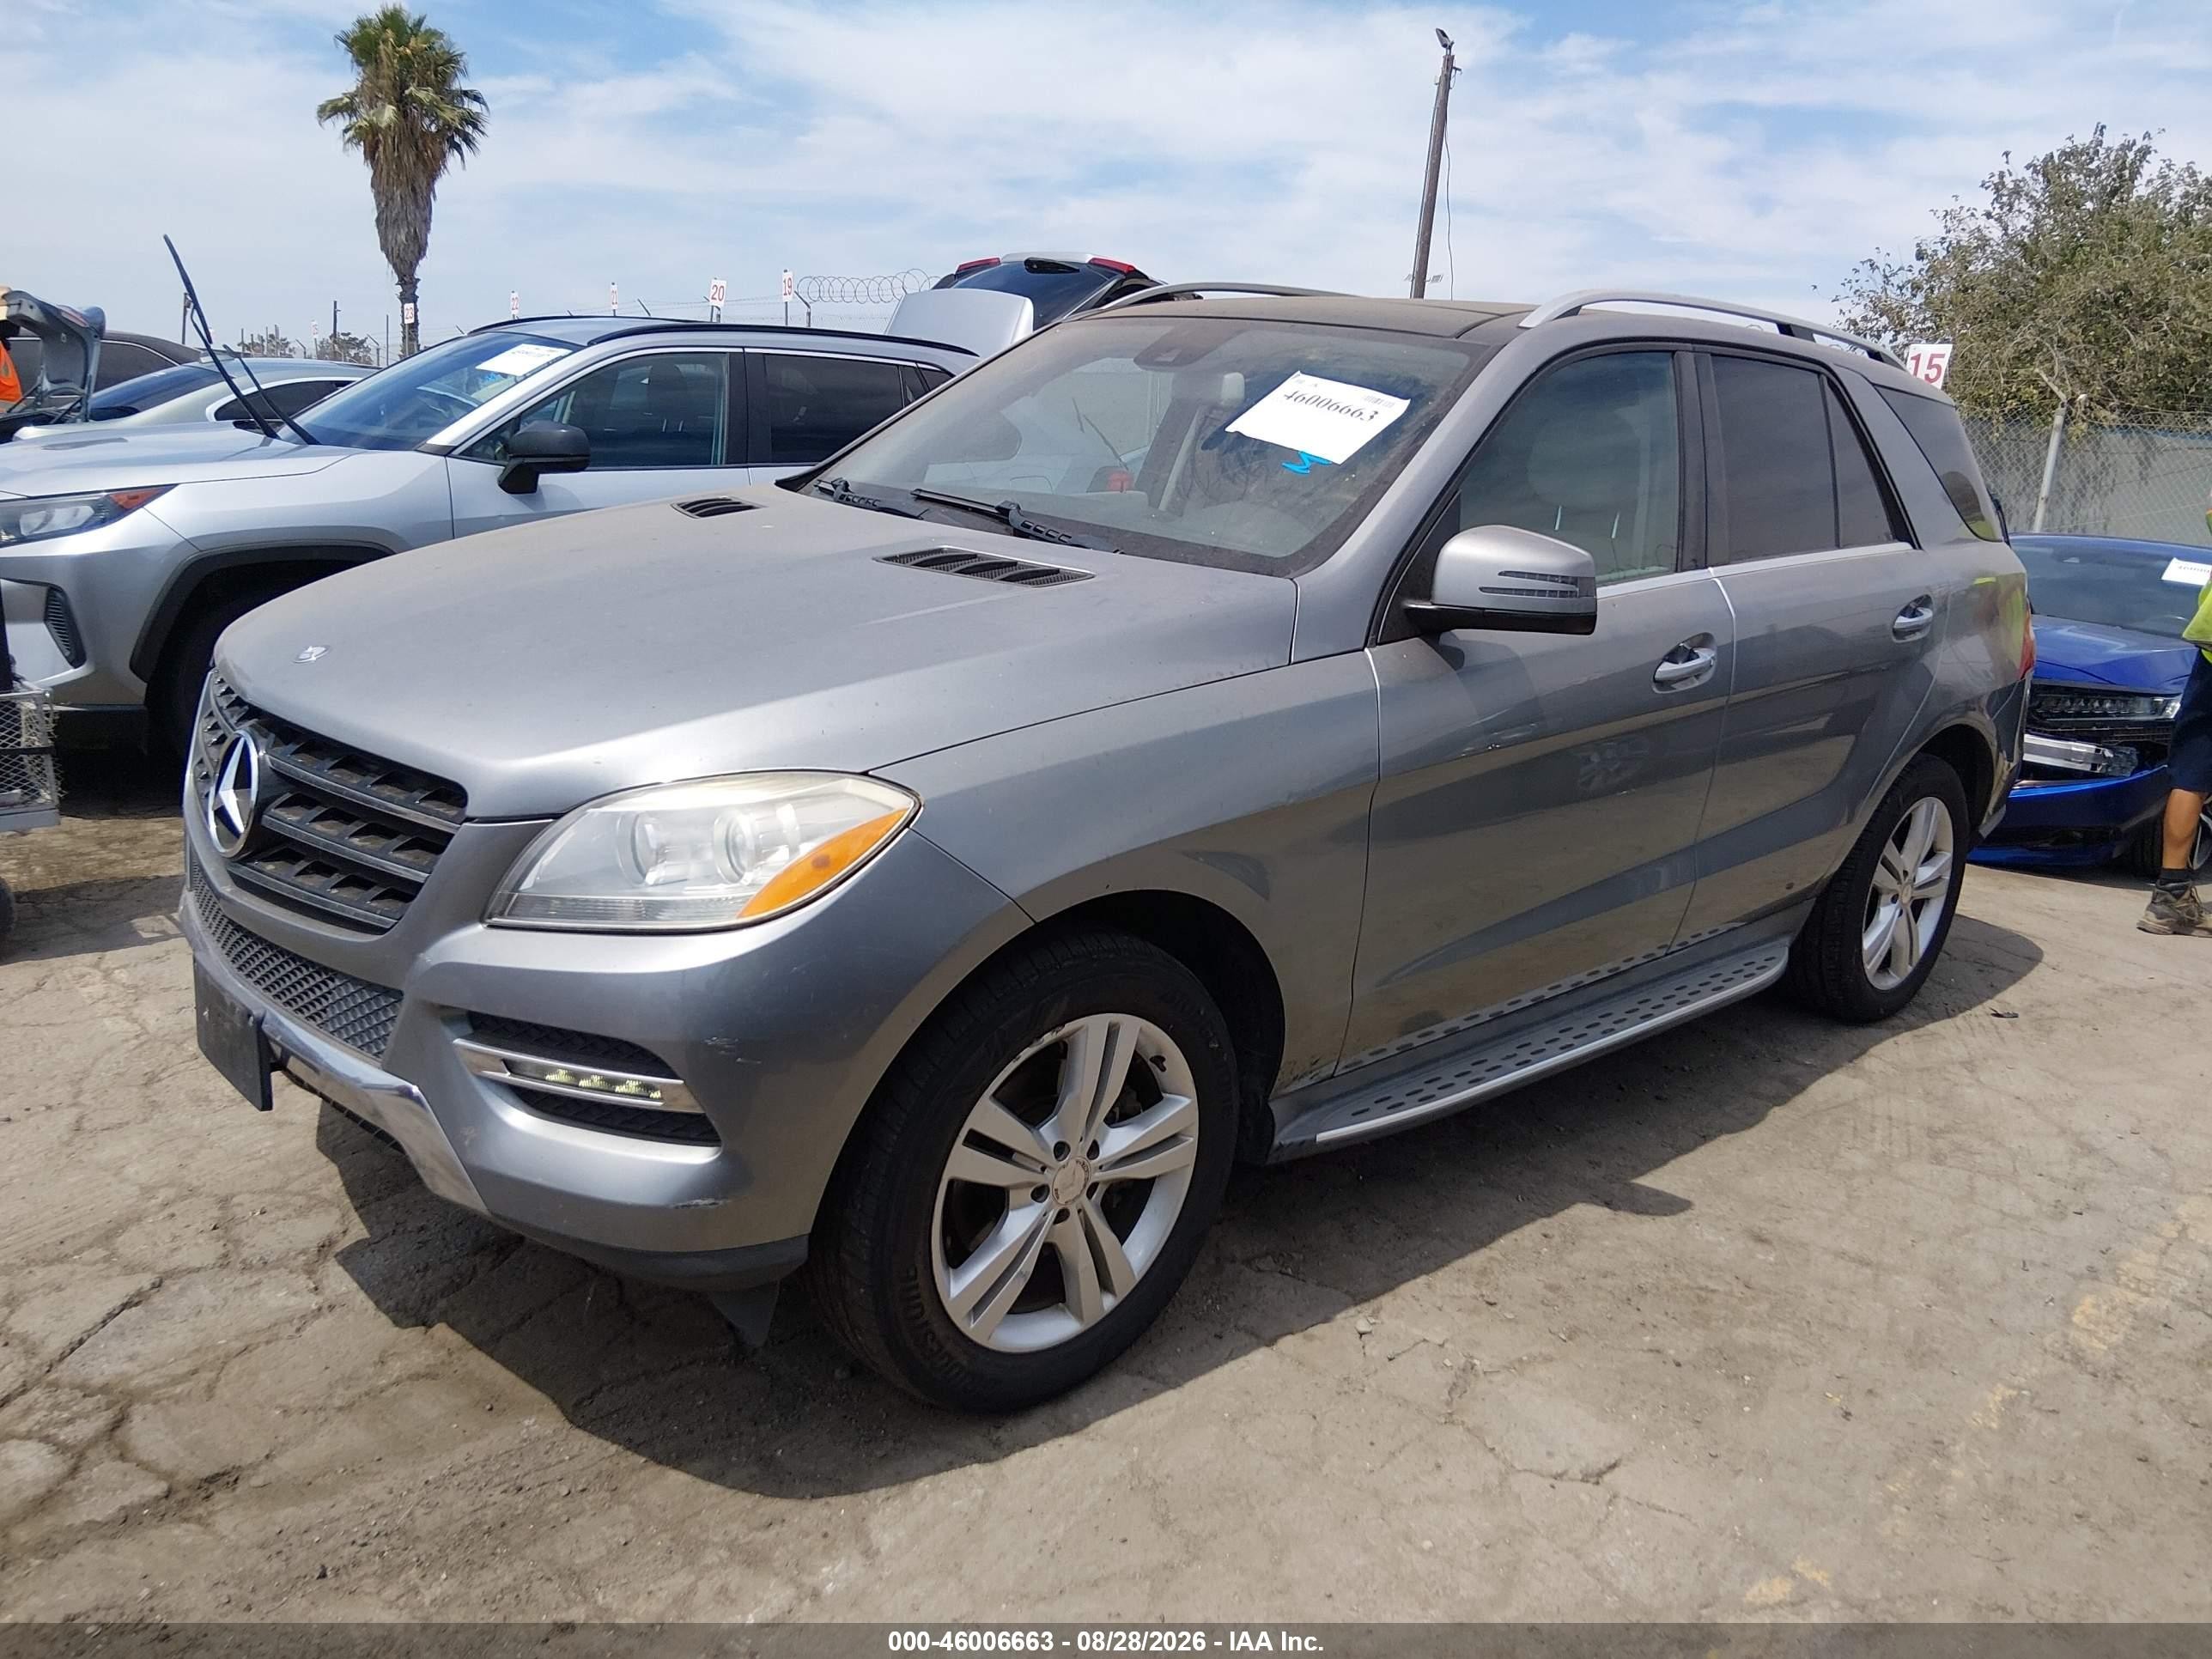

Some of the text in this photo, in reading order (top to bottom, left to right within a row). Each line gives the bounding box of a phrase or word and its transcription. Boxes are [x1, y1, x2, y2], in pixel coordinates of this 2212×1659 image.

[711, 284, 725, 301] 20
[782, 277, 793, 296] 19
[404, 307, 414, 319] 23
[1910, 353, 1946, 384] 15
[1284, 390, 1379, 422] 46006663
